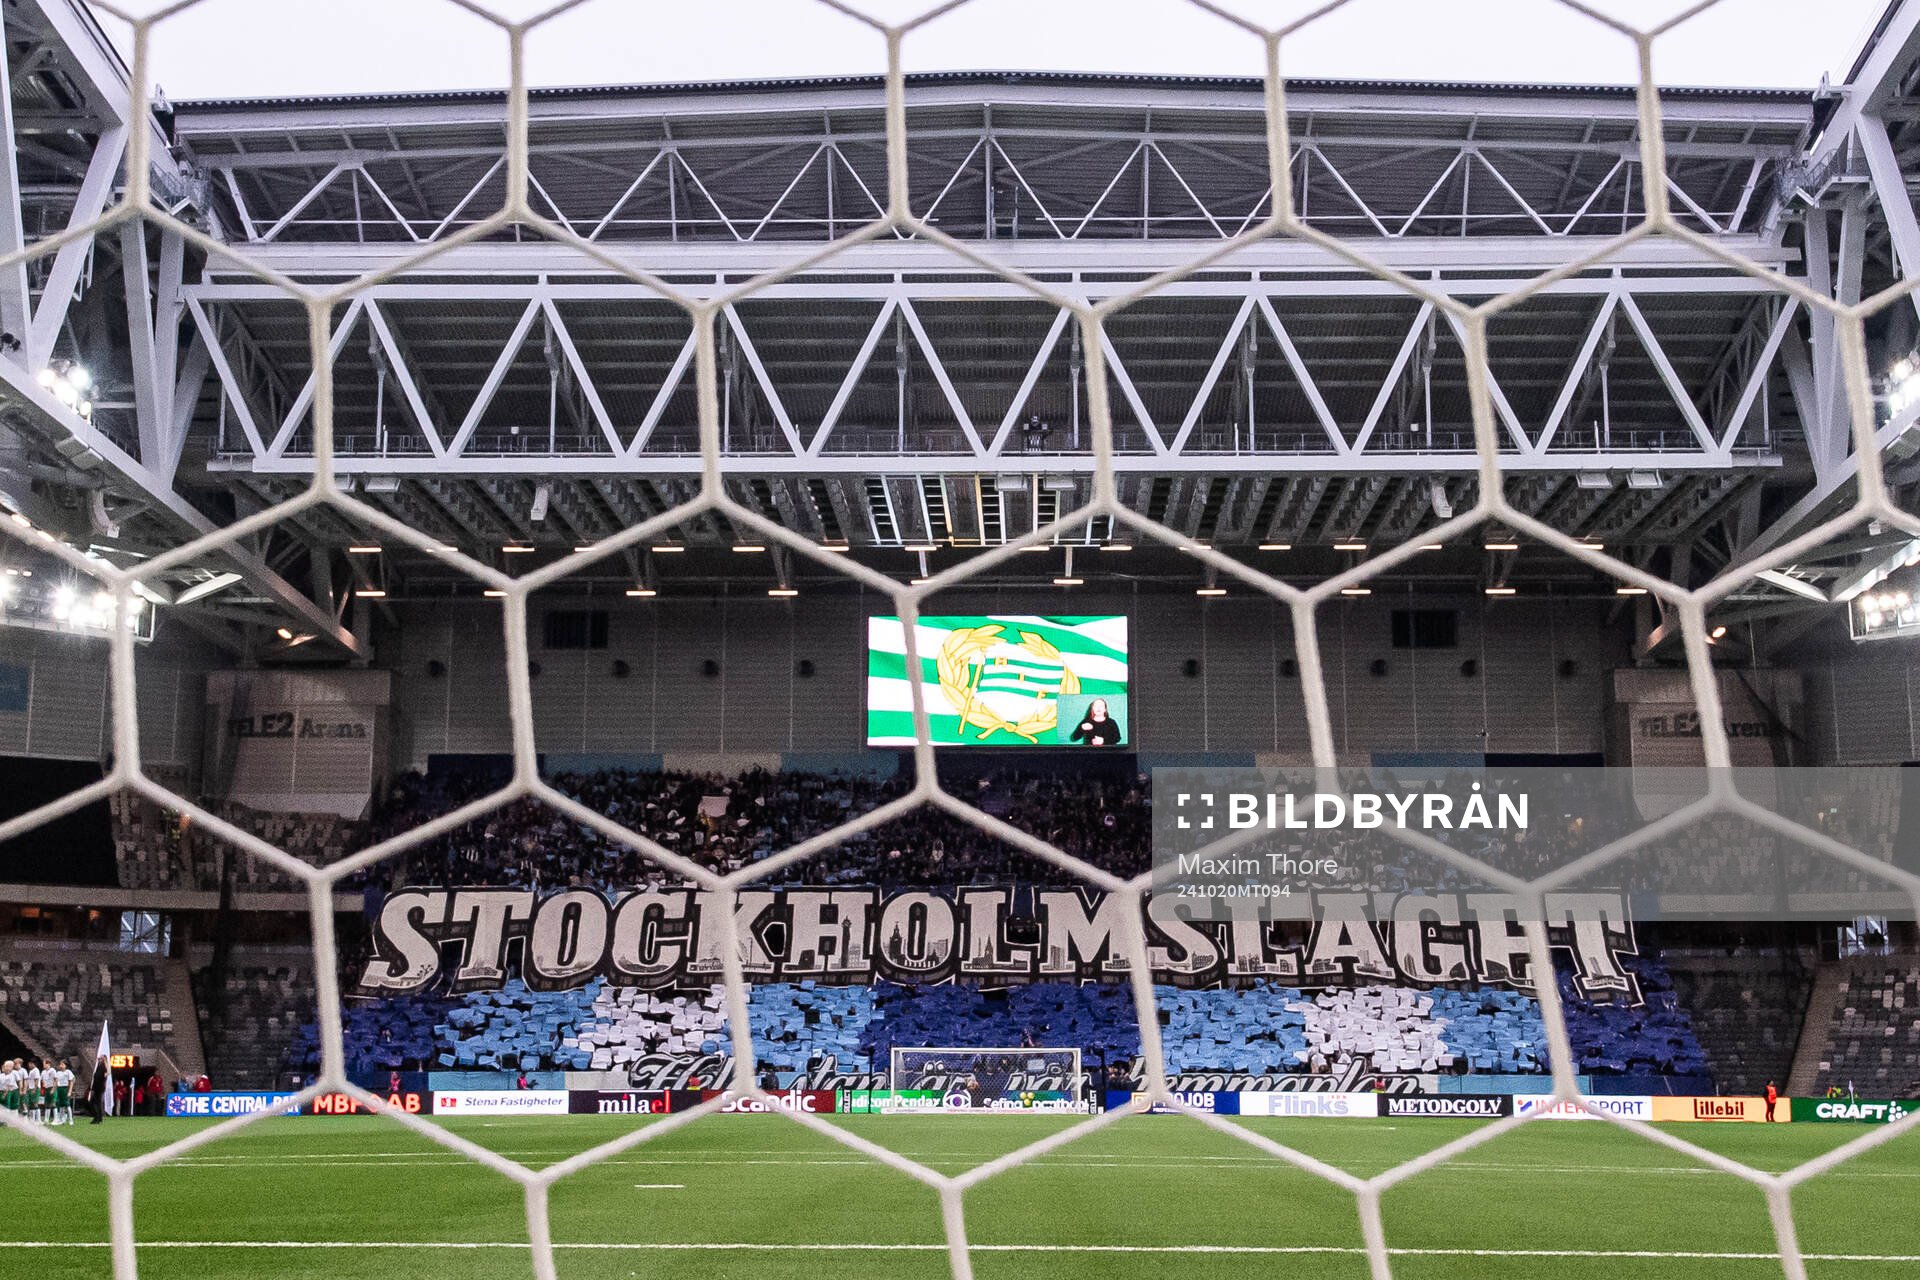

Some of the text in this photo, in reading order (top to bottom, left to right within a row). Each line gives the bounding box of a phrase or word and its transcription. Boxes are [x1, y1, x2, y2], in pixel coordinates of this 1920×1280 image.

[359, 886, 1640, 996] STOCKHOLMSLAGET
[184, 1096, 210, 1114] THE
[212, 1095, 267, 1114] CENTRAL
[387, 1093, 421, 1113] AB
[465, 1097, 563, 1108] Stena Fastigheter
[1268, 1095, 1349, 1115] Flinks
[1388, 1098, 1502, 1114] METODGOLV
[1694, 1099, 1744, 1119] Lillebil
[1816, 1103, 1888, 1119] CRAFT
